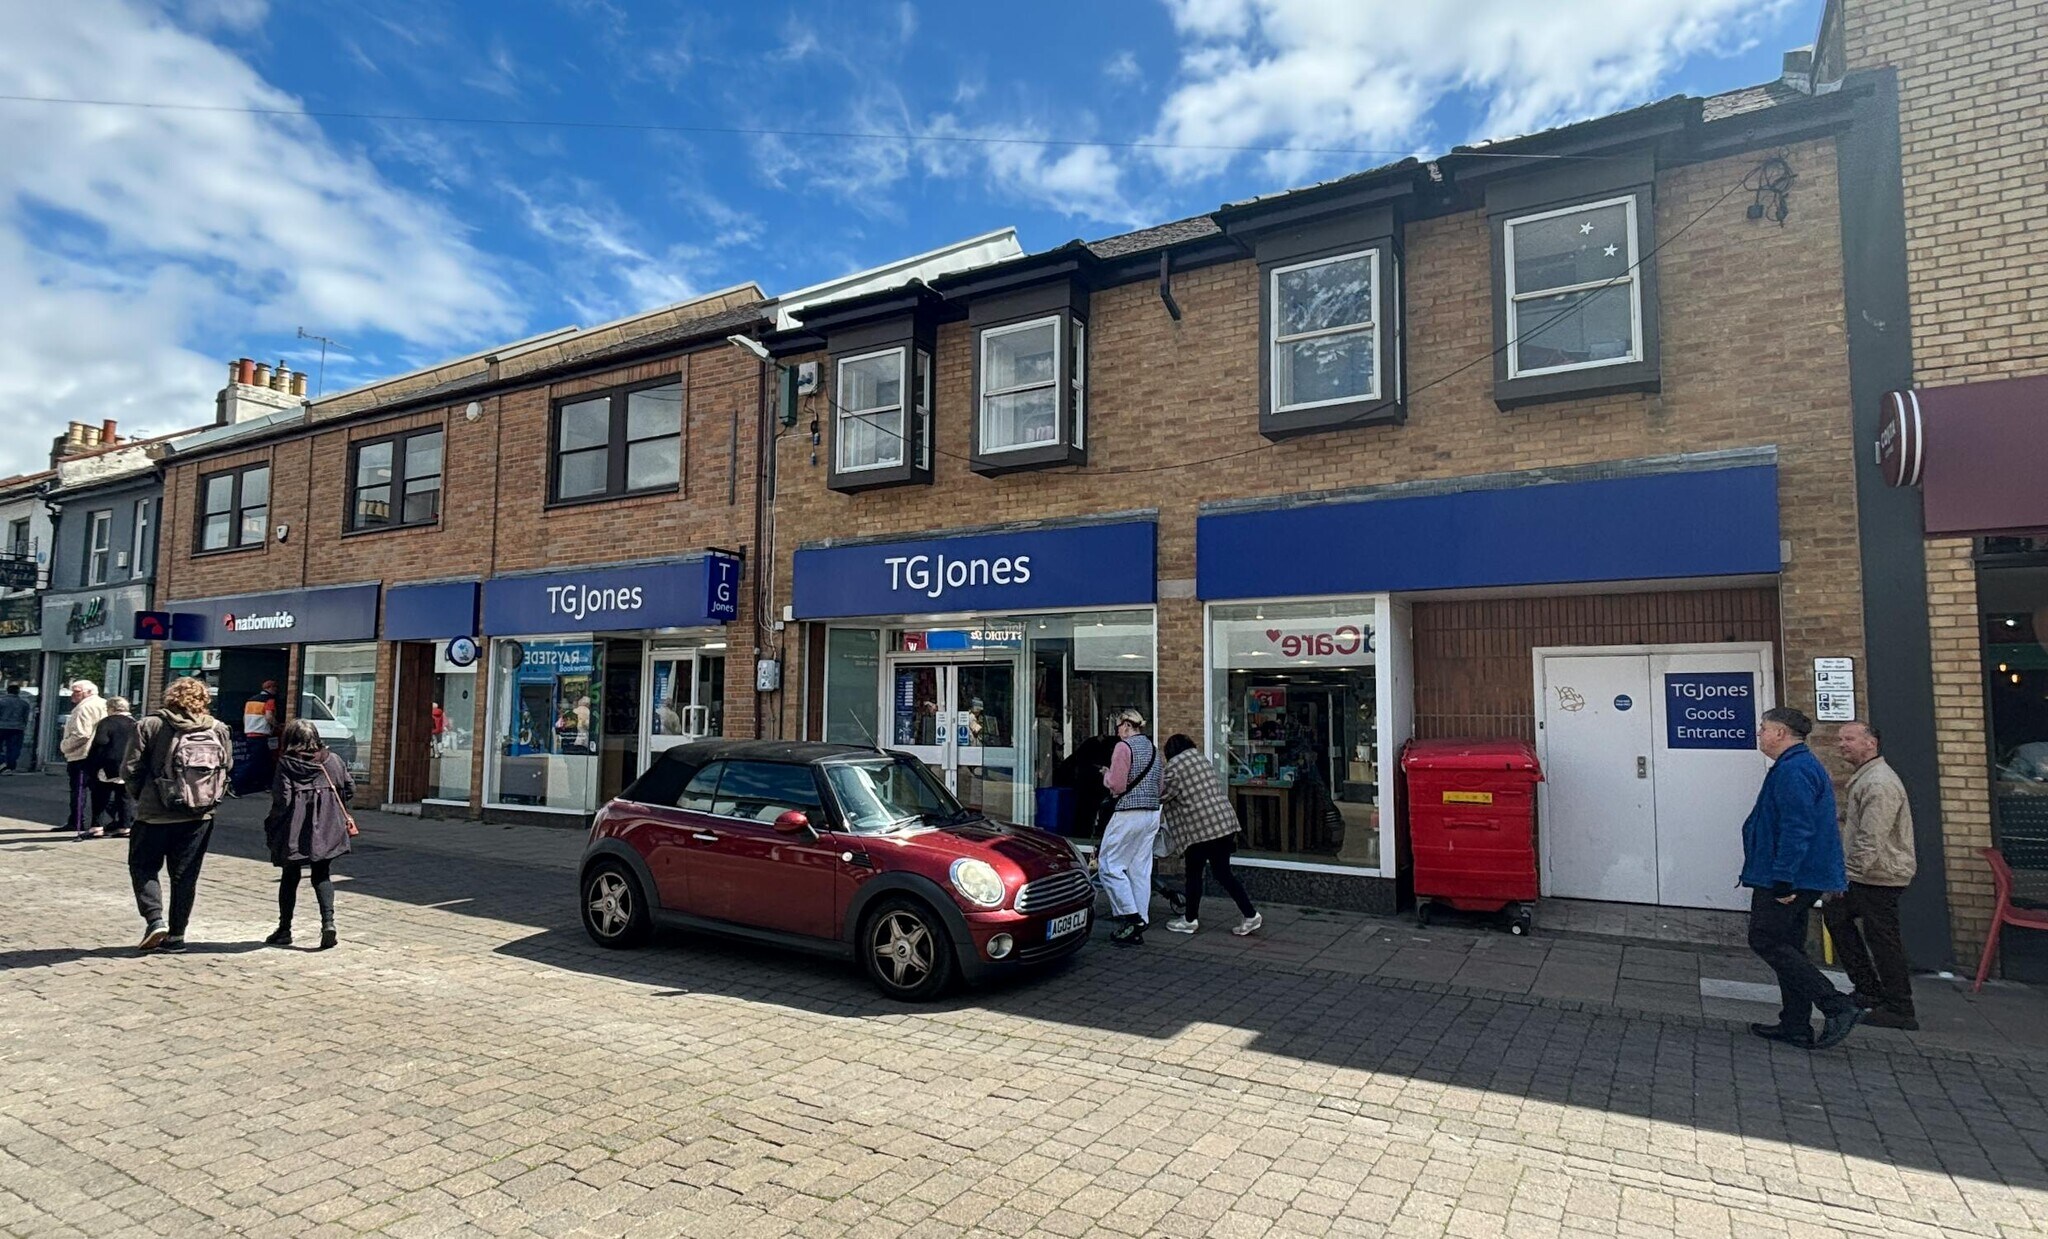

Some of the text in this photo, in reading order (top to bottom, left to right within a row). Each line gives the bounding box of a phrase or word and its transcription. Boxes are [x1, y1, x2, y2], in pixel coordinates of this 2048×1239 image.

[718, 562, 731, 581] T
[885, 554, 1031, 598] TGJones
[546, 584, 643, 620] TGJones
[717, 583, 730, 602] G
[711, 601, 734, 613] Jones
[235, 611, 295, 631] nationwide
[1670, 683, 1749, 701] TGJones
[1685, 707, 1736, 721] Goods
[1677, 725, 1746, 739] Entrance
